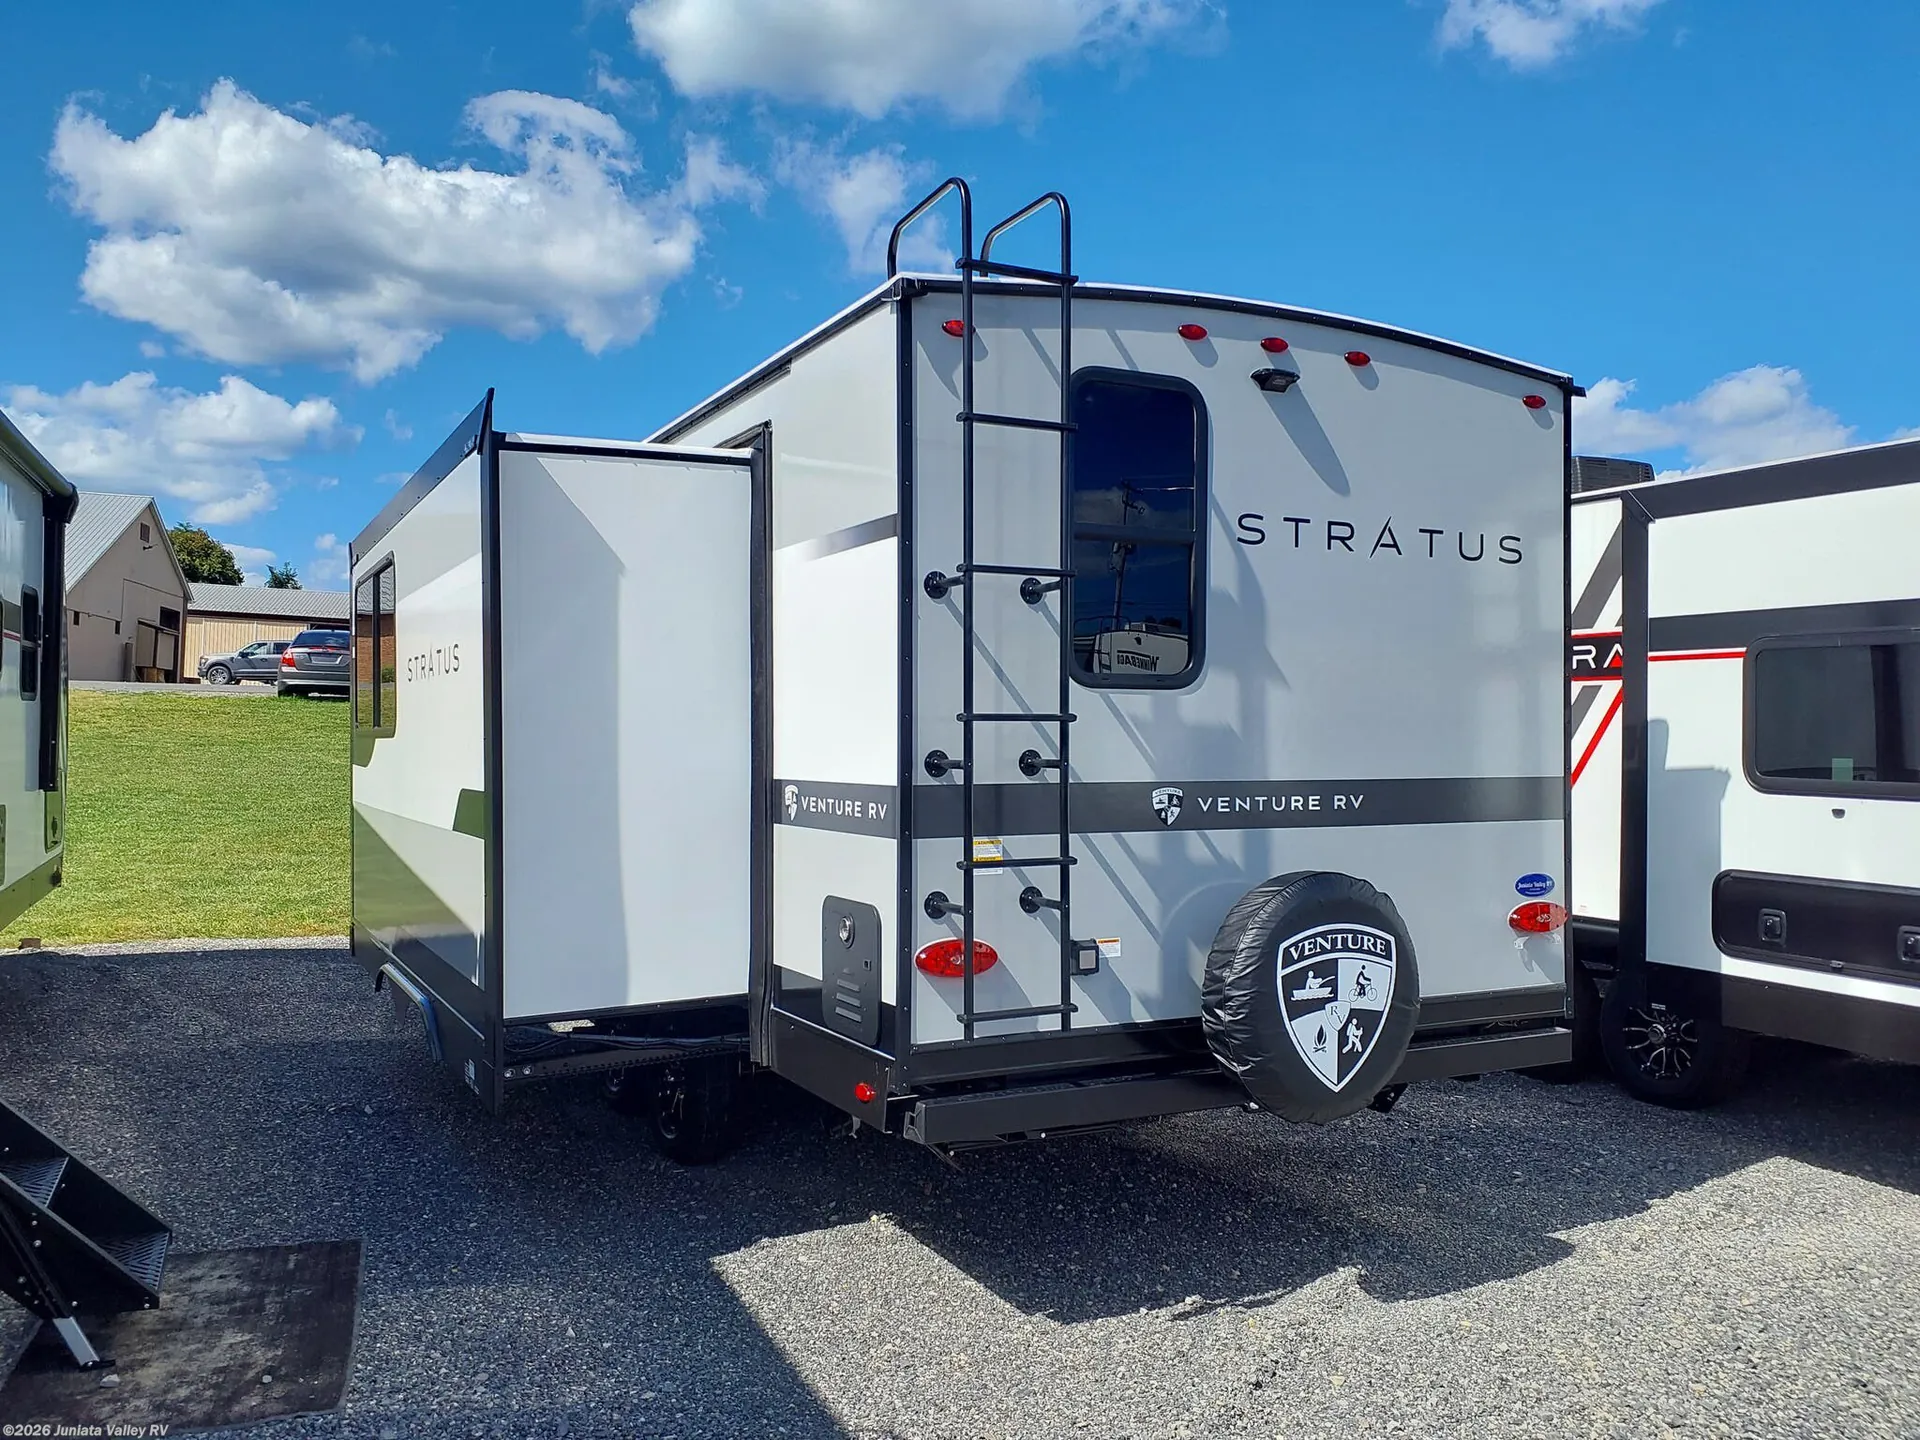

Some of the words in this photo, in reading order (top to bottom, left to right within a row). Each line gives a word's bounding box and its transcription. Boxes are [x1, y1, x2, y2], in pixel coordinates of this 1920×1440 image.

[1236, 513, 1523, 565] STRATUS
[407, 642, 460, 682] STRATUS
[801, 796, 862, 818] VENTURE
[868, 802, 887, 820] RV
[1198, 796, 1321, 812] VENTURE
[1333, 795, 1364, 810] RV
[1289, 933, 1387, 961] VENTURE
